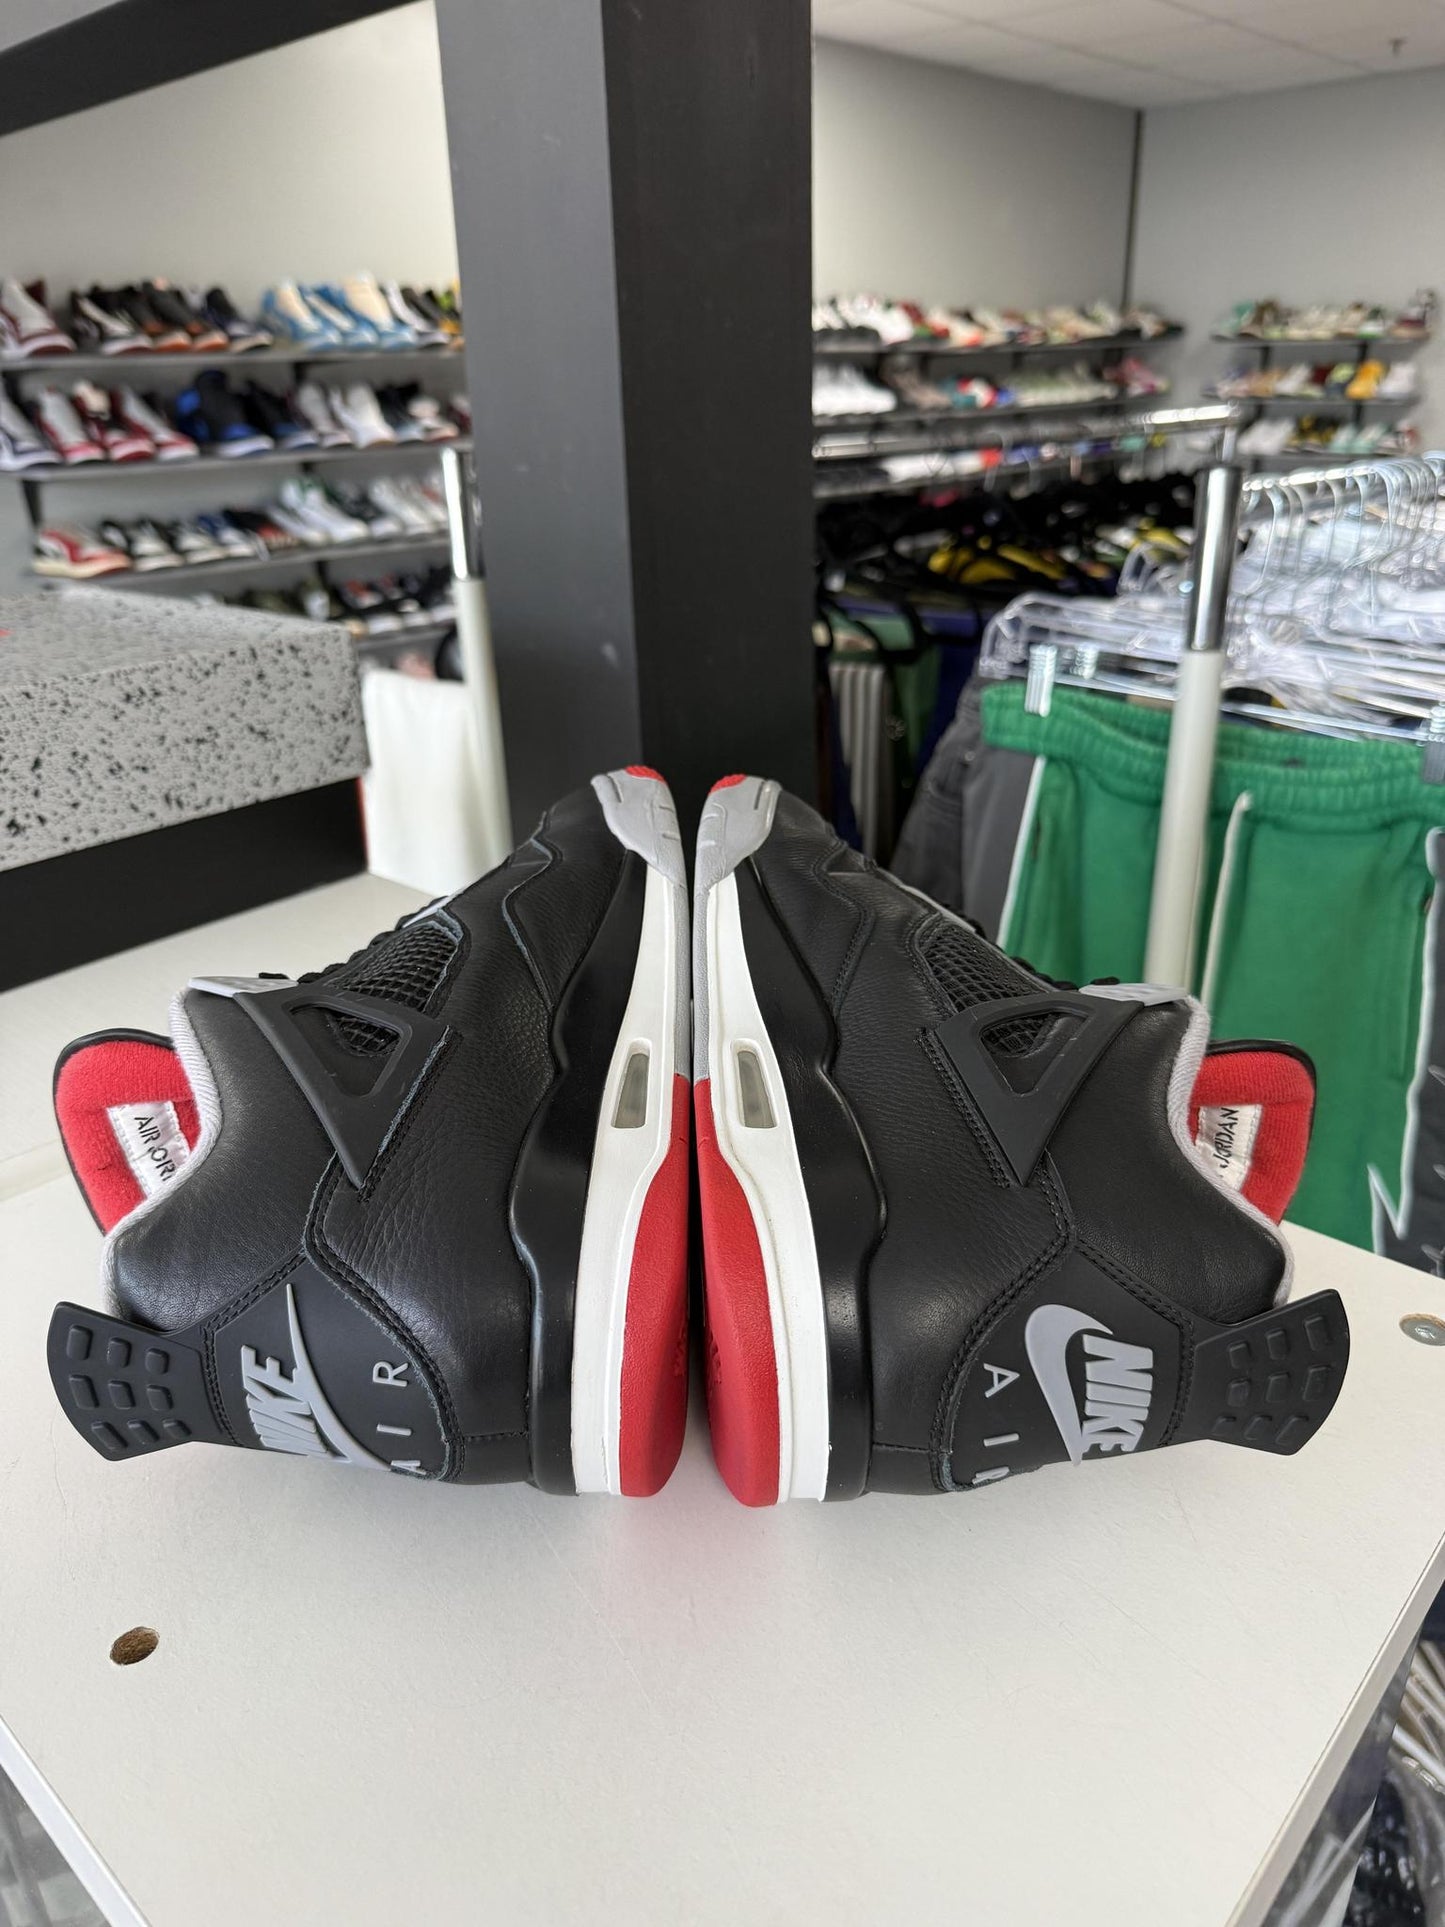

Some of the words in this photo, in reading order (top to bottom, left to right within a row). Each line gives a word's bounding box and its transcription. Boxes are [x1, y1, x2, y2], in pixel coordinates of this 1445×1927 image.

[134, 1116, 161, 1144] AIR
[241, 1345, 330, 1460] NIKE
[1082, 1333, 1153, 1453] NIKE
